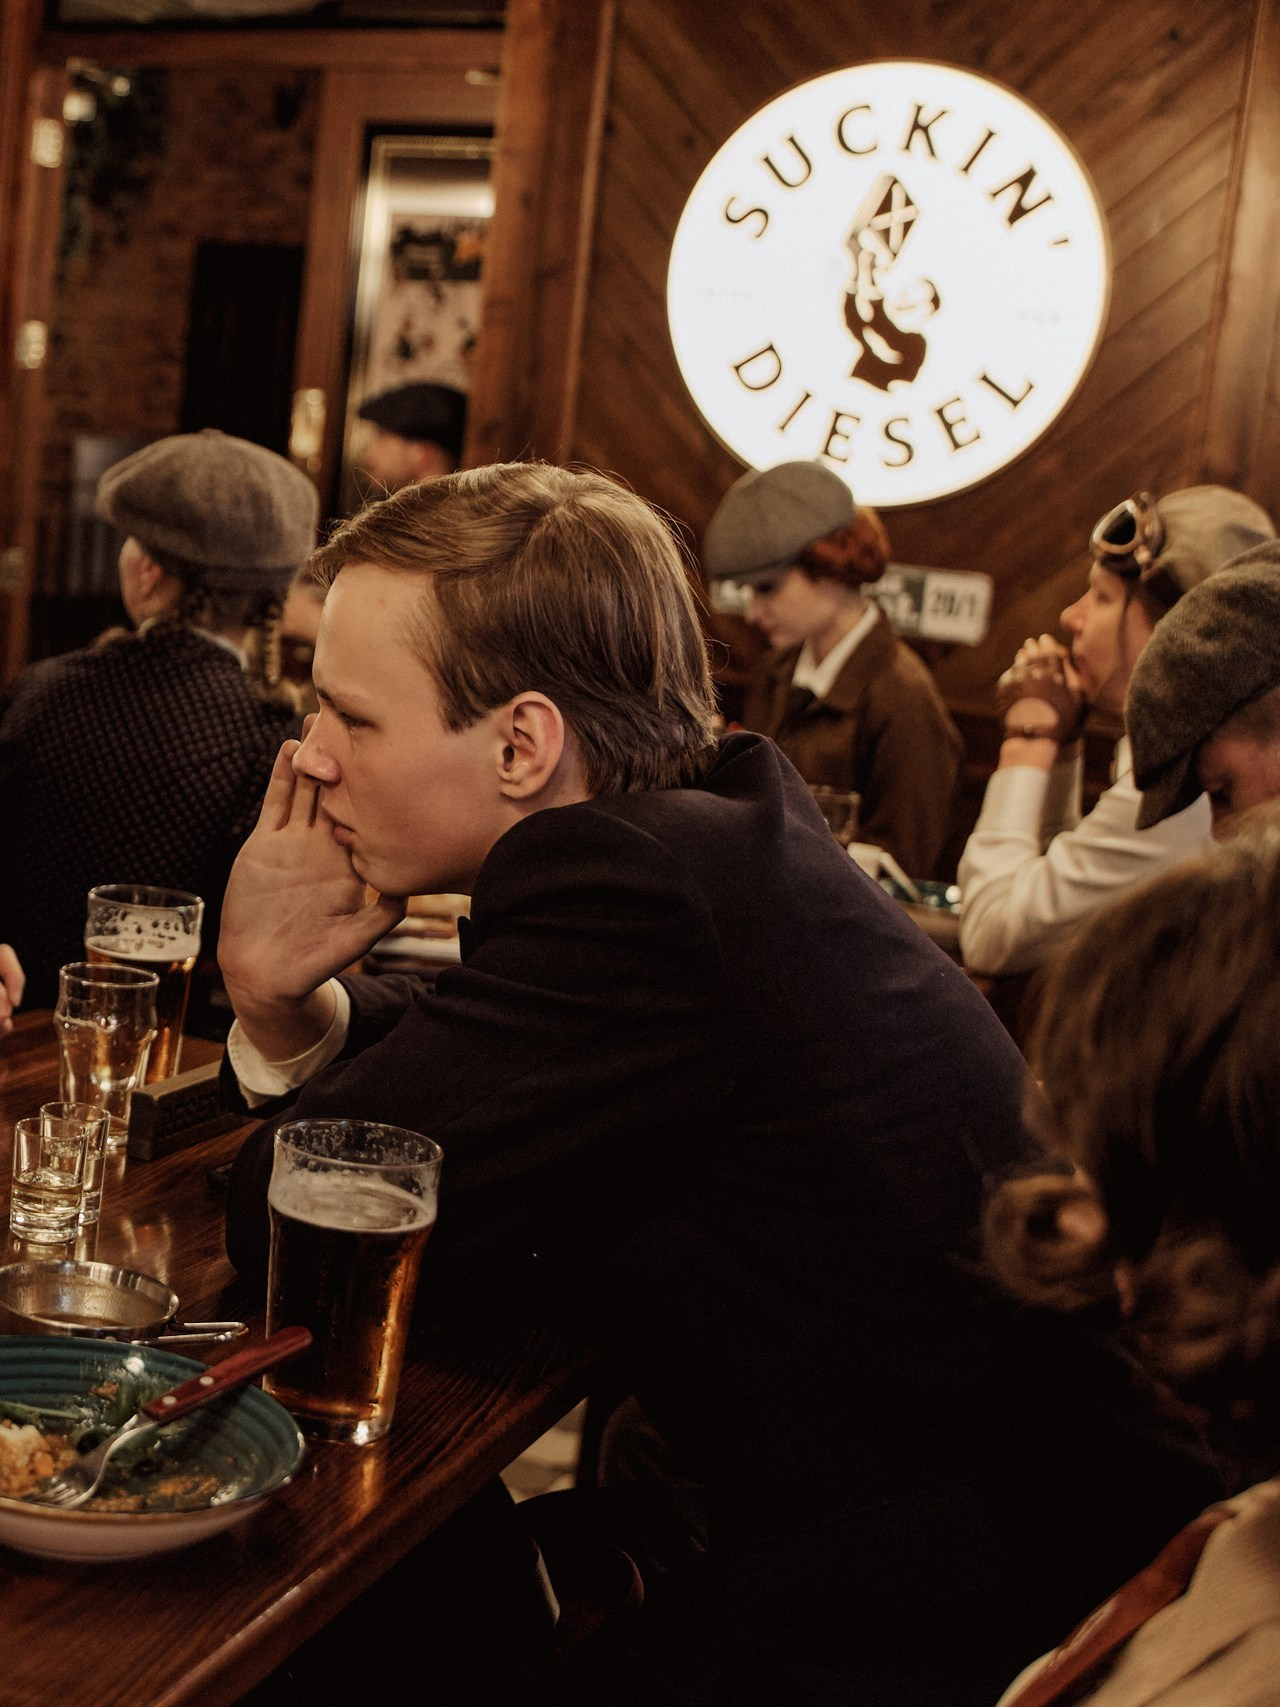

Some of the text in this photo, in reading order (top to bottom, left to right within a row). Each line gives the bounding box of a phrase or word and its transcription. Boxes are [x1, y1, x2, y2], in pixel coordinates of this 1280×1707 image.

[725, 104, 1069, 249] SUCKIN'
[733, 343, 1034, 467] DIESEL
[157, 1091, 220, 1133] RESER
